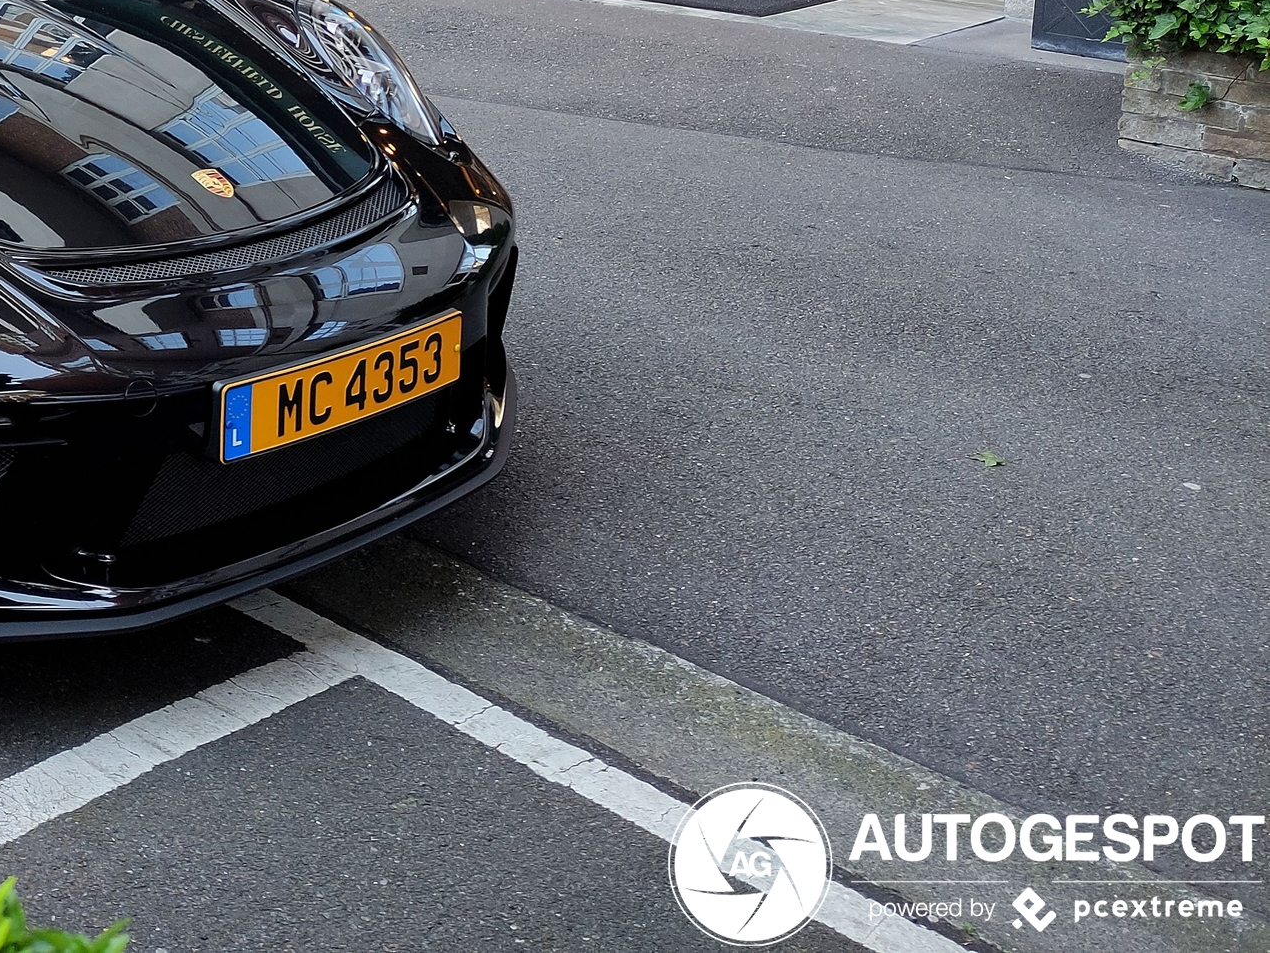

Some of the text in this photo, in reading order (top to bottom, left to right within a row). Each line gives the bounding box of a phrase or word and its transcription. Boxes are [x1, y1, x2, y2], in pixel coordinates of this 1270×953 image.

[277, 332, 443, 437] MC 4353
[231, 427, 243, 447] L
